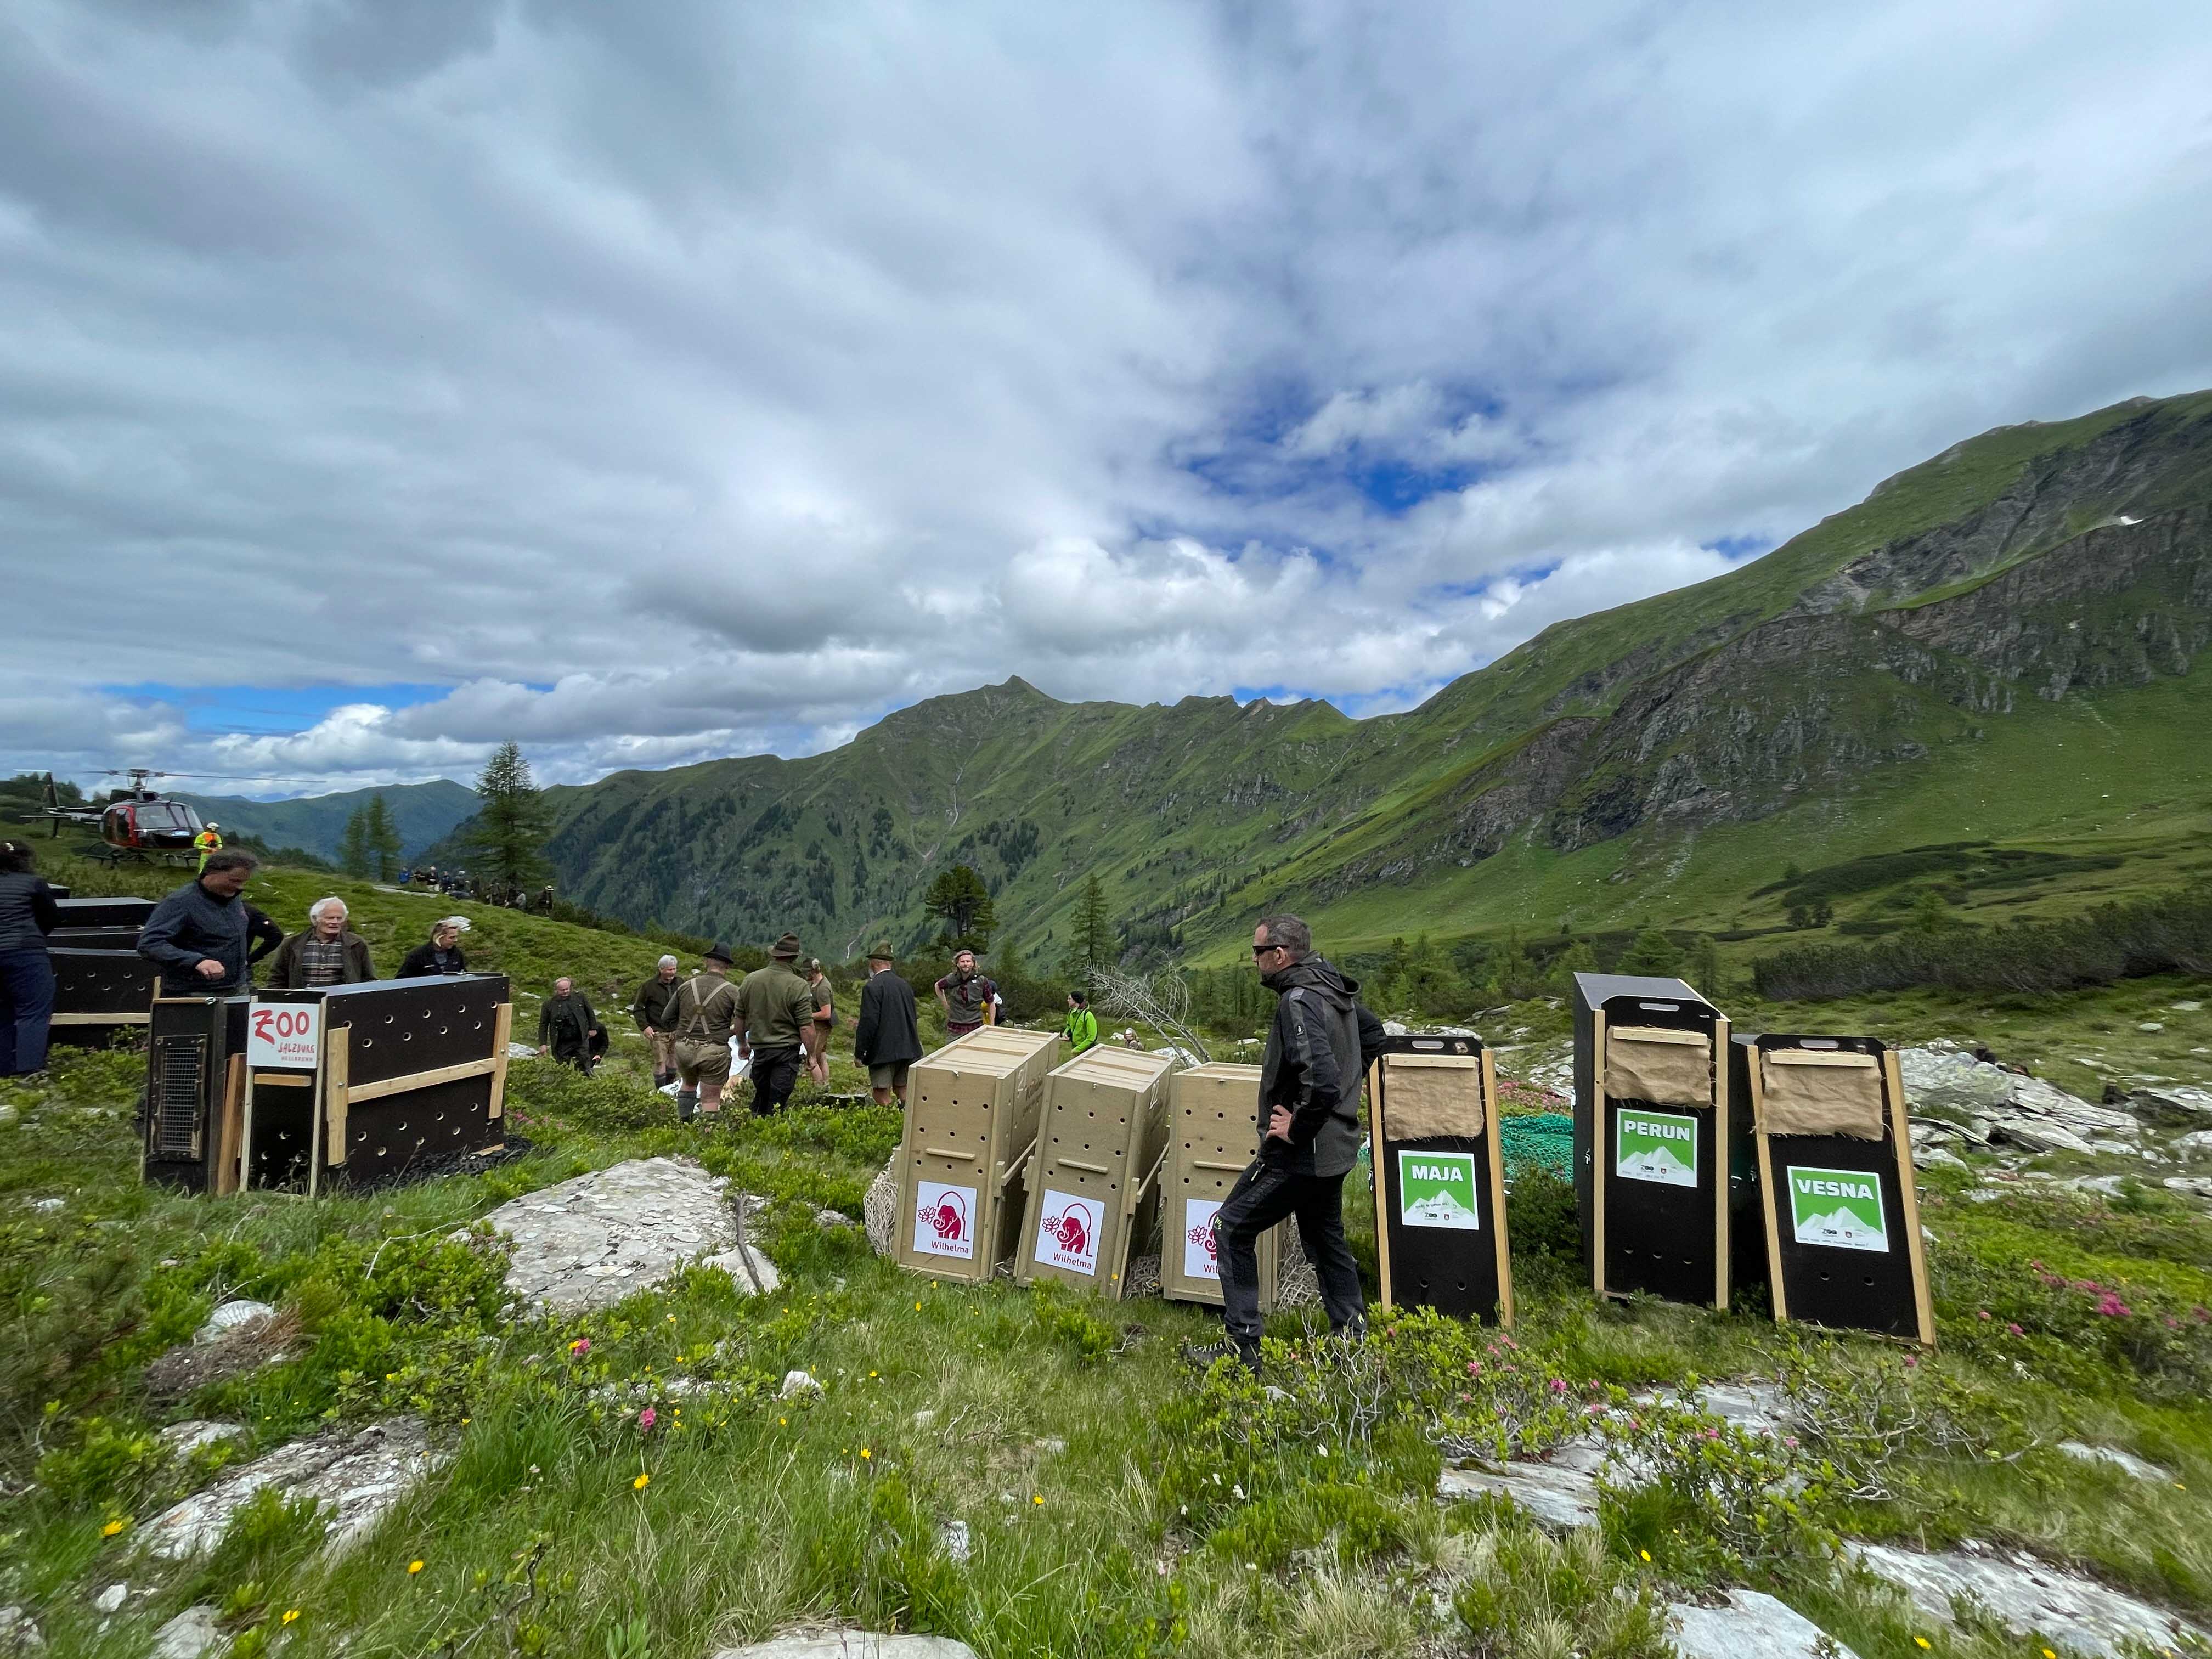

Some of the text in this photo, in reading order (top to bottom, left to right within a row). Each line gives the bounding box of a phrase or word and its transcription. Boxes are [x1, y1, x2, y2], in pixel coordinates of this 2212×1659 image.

[252, 1010, 309, 1045] ZOO
[278, 1042, 314, 1053] SALZBURG
[1624, 1120, 1690, 1141] PERUN
[1412, 1165, 1464, 1182] MAJA
[1796, 1178, 1874, 1200] VESNA
[932, 1240, 969, 1254] Wilhelma
[1053, 1252, 1091, 1269] Wilhelma
[1204, 1264, 1219, 1274] Wil
